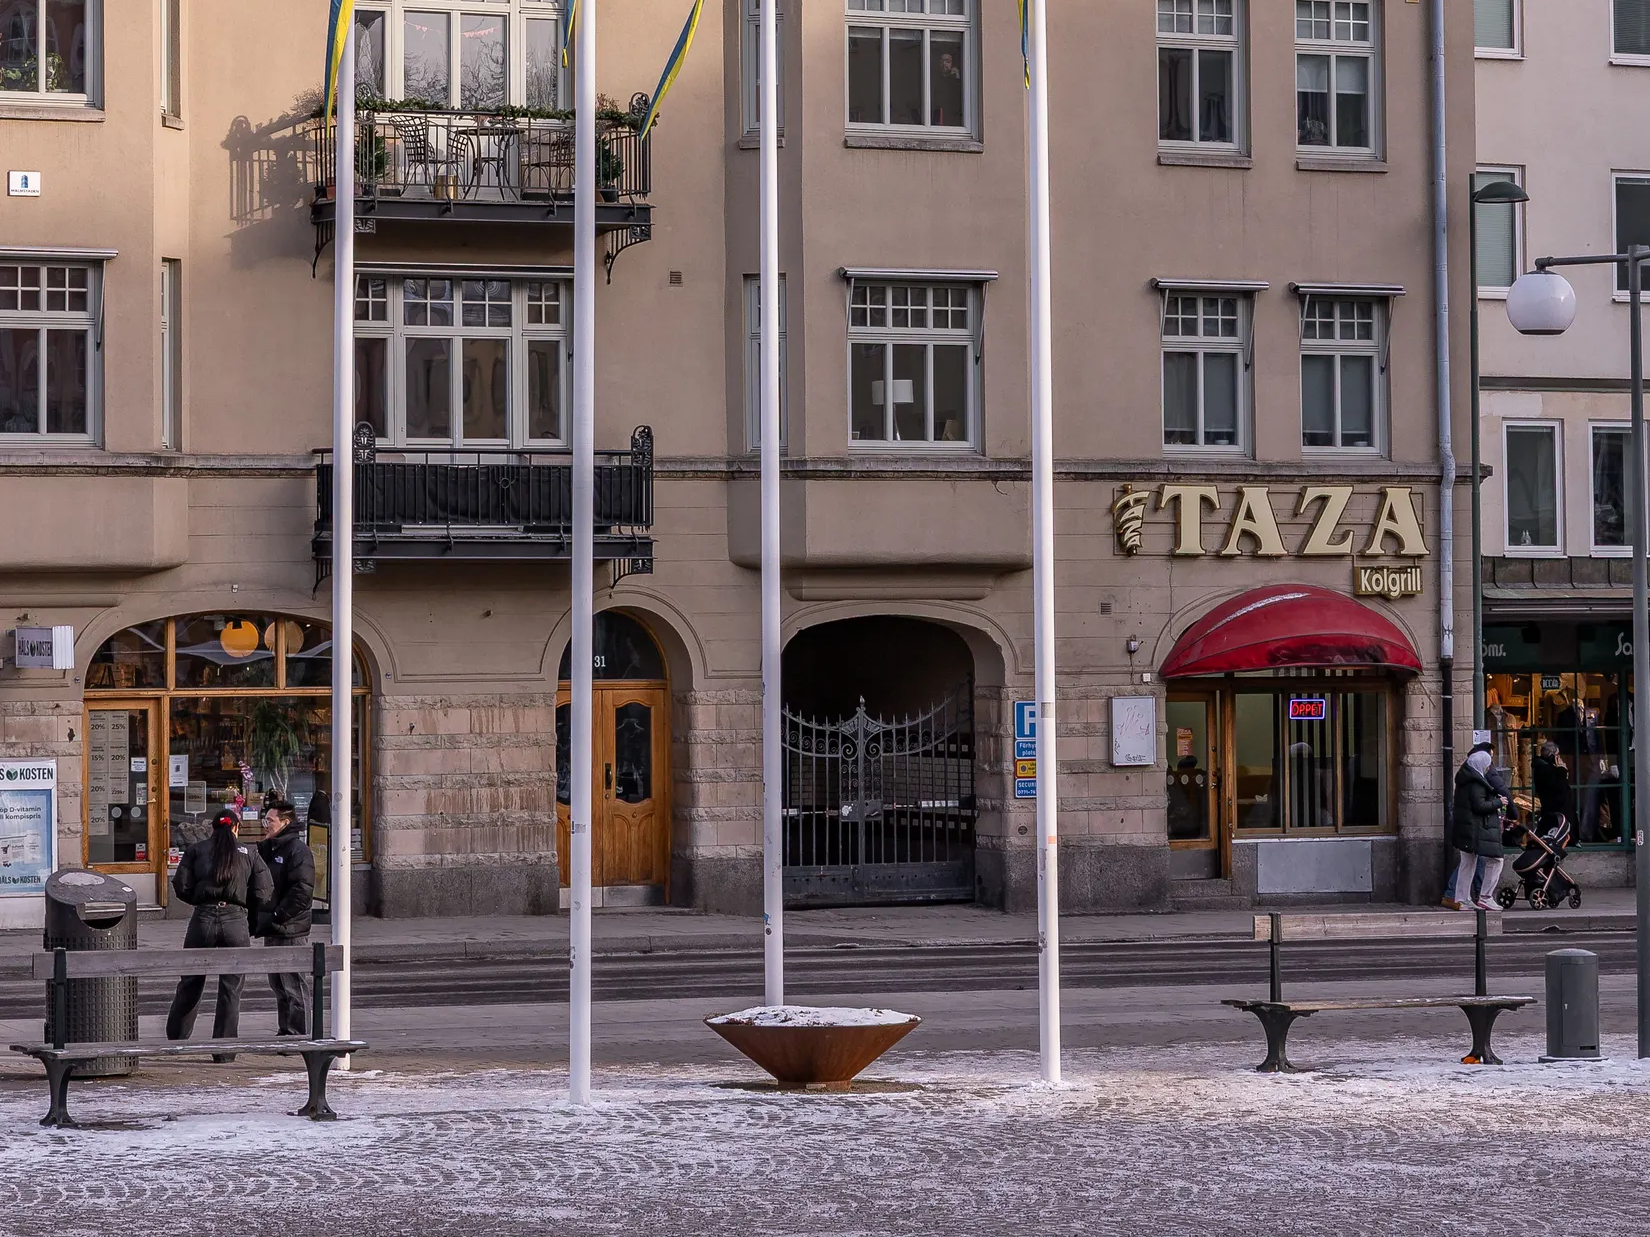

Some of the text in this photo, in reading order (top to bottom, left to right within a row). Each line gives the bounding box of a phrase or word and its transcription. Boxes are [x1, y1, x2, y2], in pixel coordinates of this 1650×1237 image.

[1157, 484, 1431, 556] TAZA
[1360, 568, 1422, 597] Kolgrill
[594, 655, 606, 668] 31
[1291, 701, 1323, 716] ÖPPET
[19, 767, 54, 780] KOSTEN
[20, 875, 41, 884] KOSTEN
